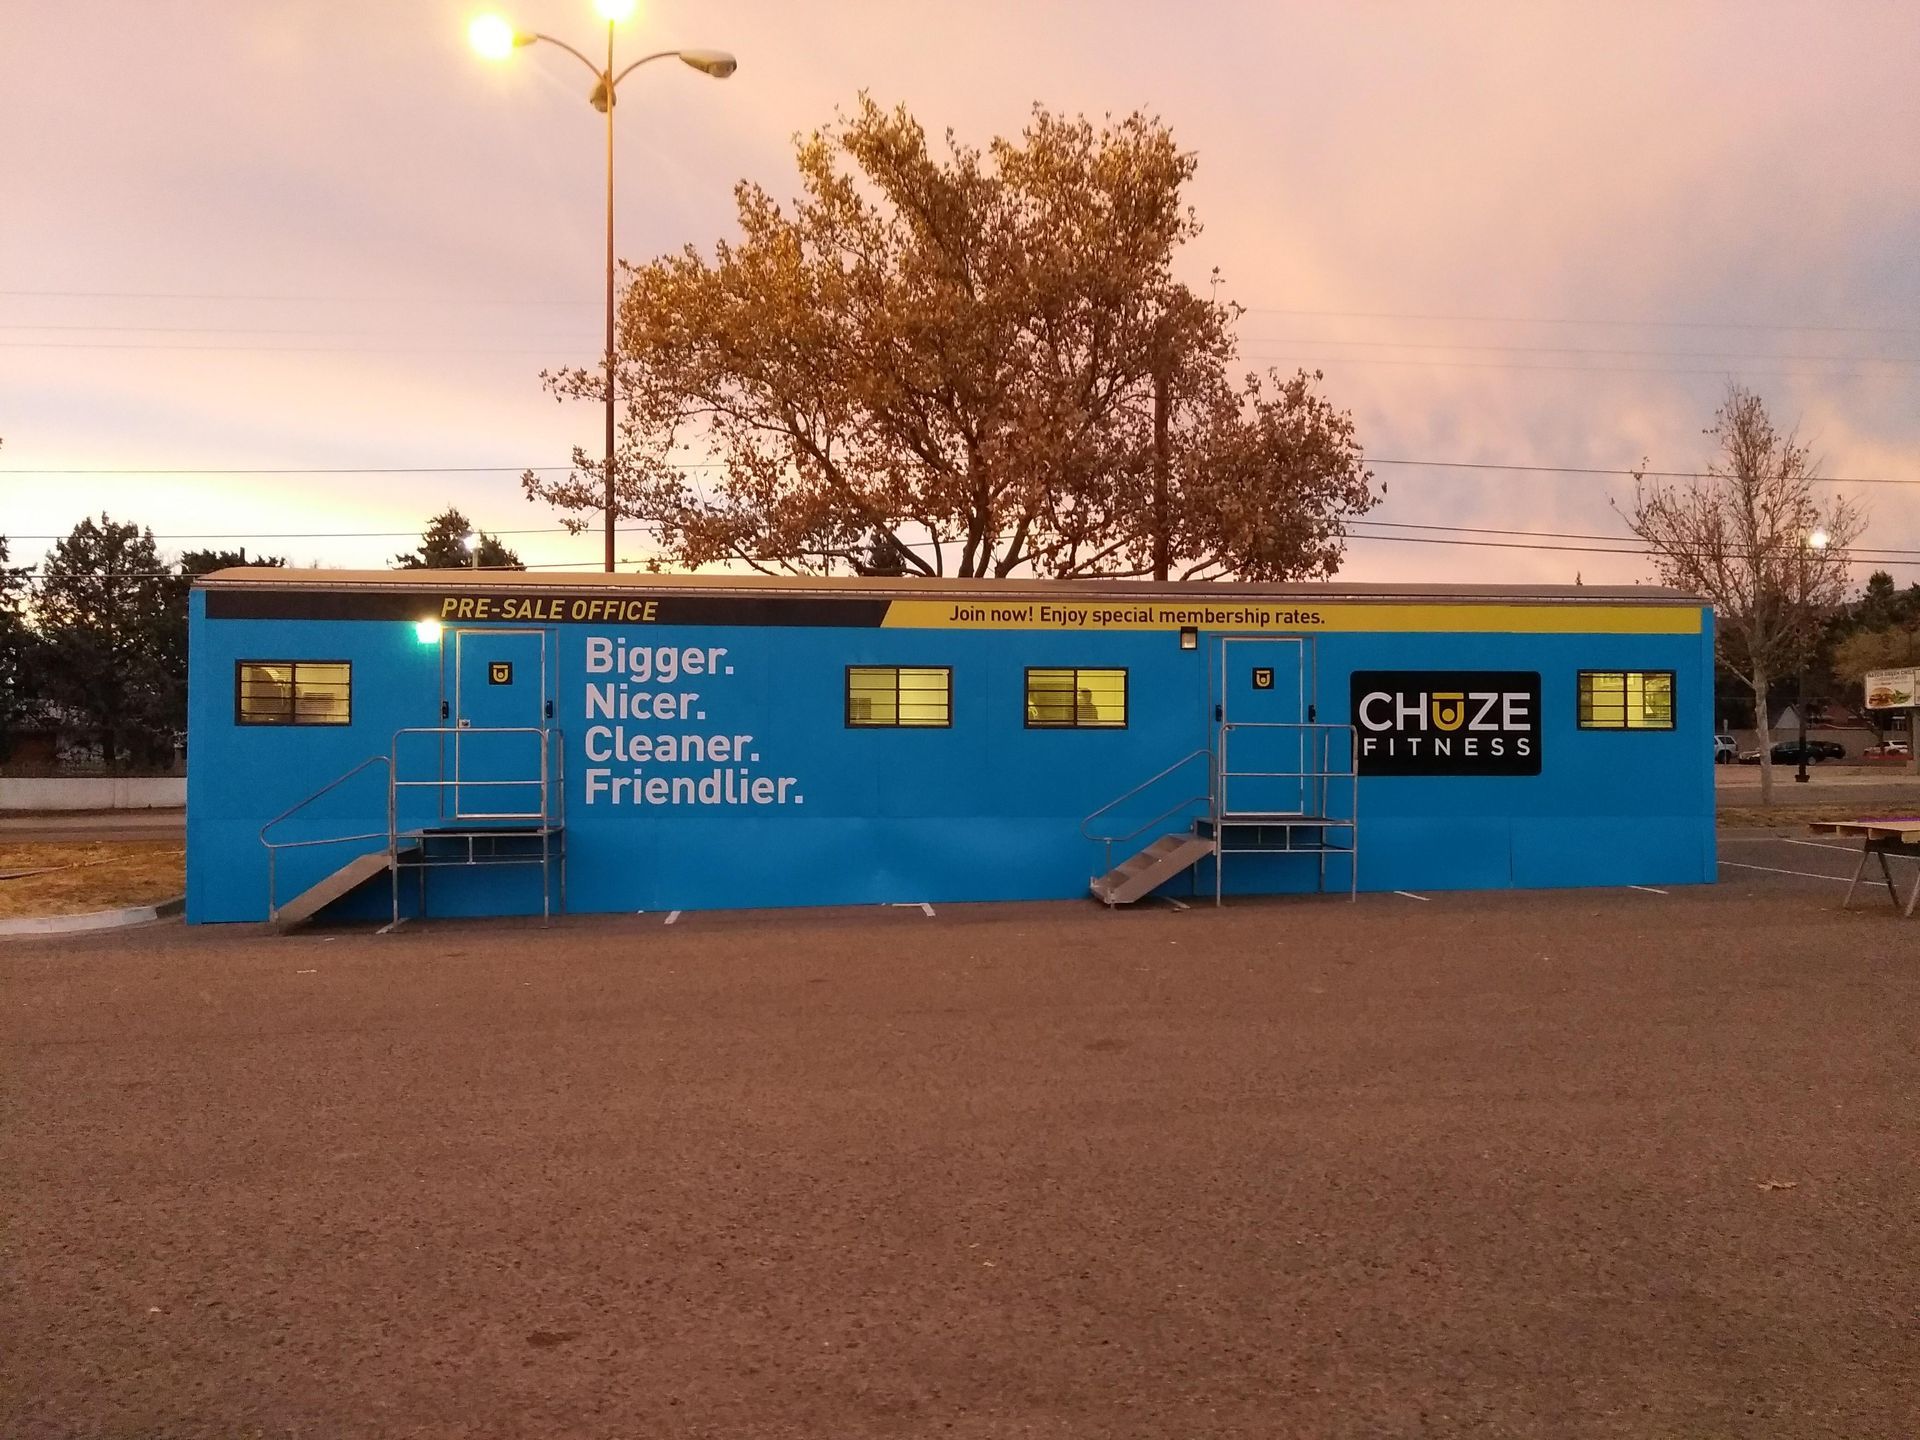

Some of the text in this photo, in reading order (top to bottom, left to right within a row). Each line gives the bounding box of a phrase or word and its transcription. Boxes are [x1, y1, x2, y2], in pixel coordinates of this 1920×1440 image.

[440, 598, 659, 621] PRE-SALE OFFICE
[950, 605, 1326, 627] Join now! Enjoy special membership rates.
[586, 637, 734, 684] Bigger.
[585, 683, 706, 720] Nicer.
[1358, 691, 1531, 732] CHUZE
[585, 726, 760, 762] Cleaner.
[1363, 737, 1531, 757] FITNESS
[585, 768, 804, 805] Friendlier.
